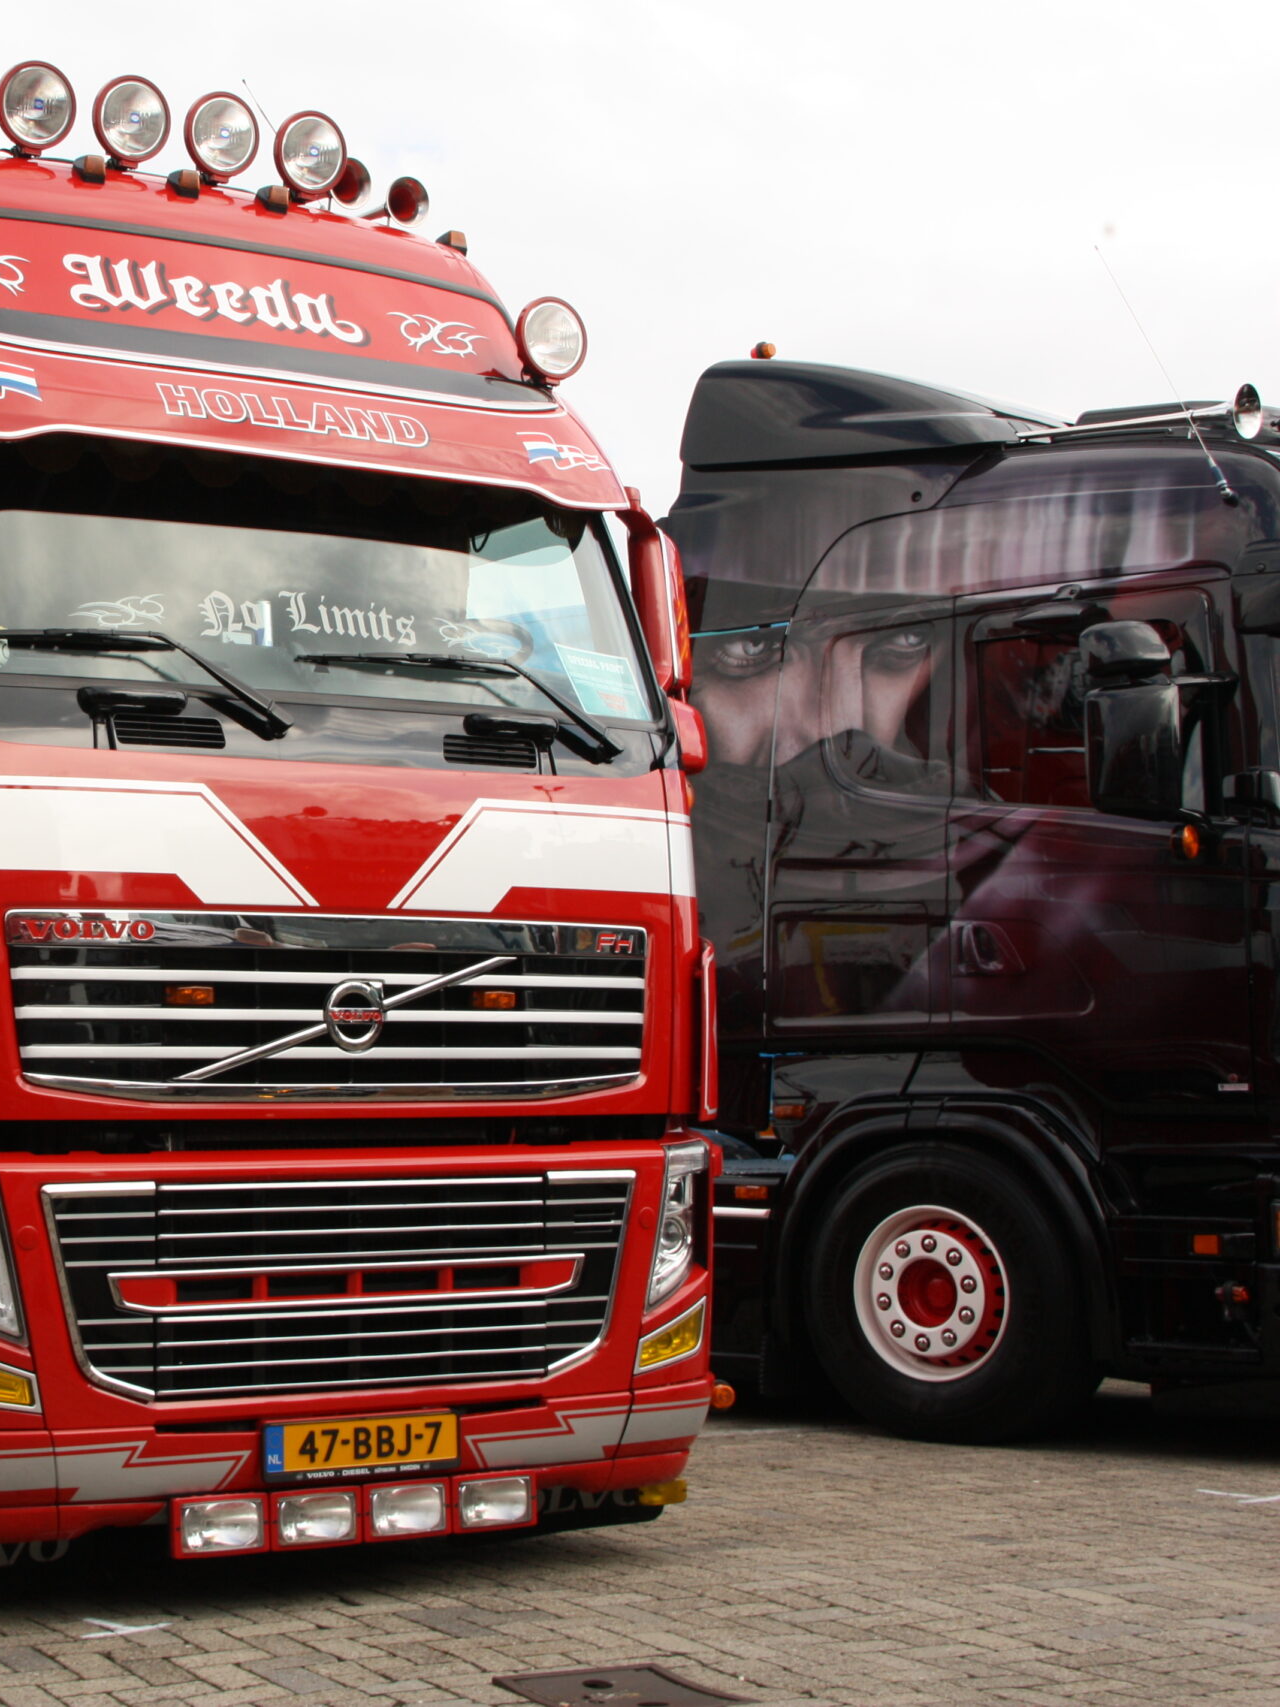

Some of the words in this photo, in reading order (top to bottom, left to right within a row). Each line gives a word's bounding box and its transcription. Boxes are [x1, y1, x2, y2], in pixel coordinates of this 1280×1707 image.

[62, 253, 366, 345] Weeda
[155, 383, 429, 448] HOLLAND
[198, 590, 263, 637] No
[278, 590, 417, 646] Limits
[21, 919, 155, 940] VOLVO
[596, 932, 633, 954] FH
[328, 1010, 383, 1021] VOLVO
[299, 1421, 442, 1464] 47-BBJ-7
[268, 1455, 283, 1465] NL
[306, 1471, 335, 1480] VOLVO
